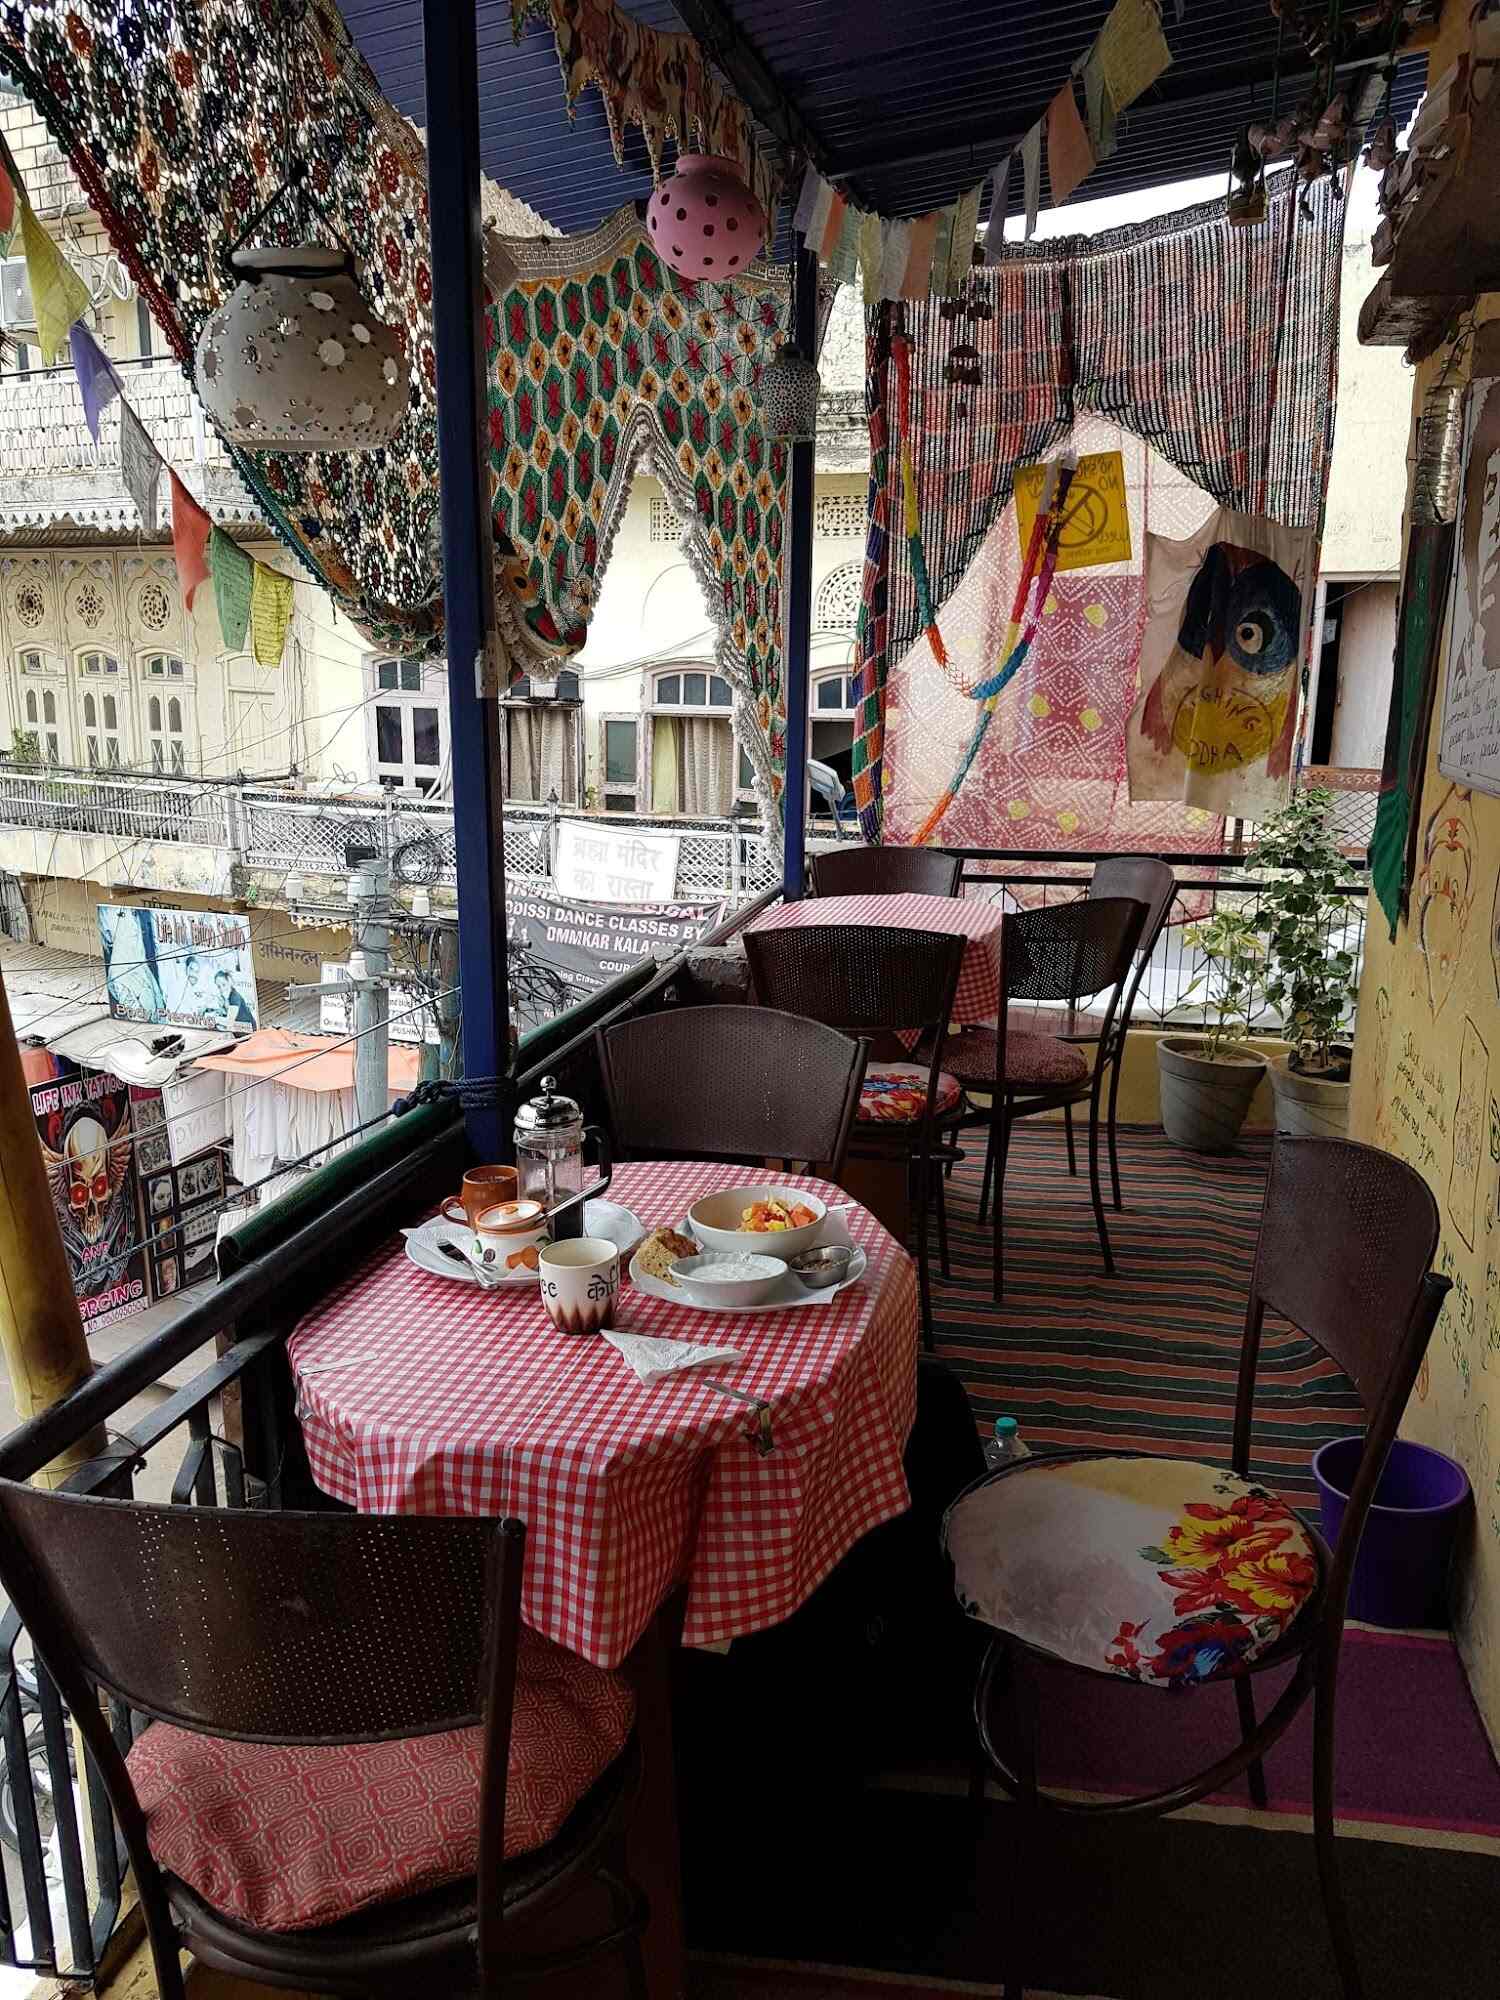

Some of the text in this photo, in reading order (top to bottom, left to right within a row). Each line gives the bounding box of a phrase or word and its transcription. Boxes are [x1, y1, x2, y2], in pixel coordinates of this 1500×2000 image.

[505, 899, 552, 921] ODISSI
[554, 907, 605, 928] DANCE
[609, 915, 680, 938] CLASSES
[683, 925, 706, 941] BY
[546, 926, 610, 950] OMMKAR
[32, 1088, 59, 1117] LIFE
[61, 1080, 83, 1107] INK
